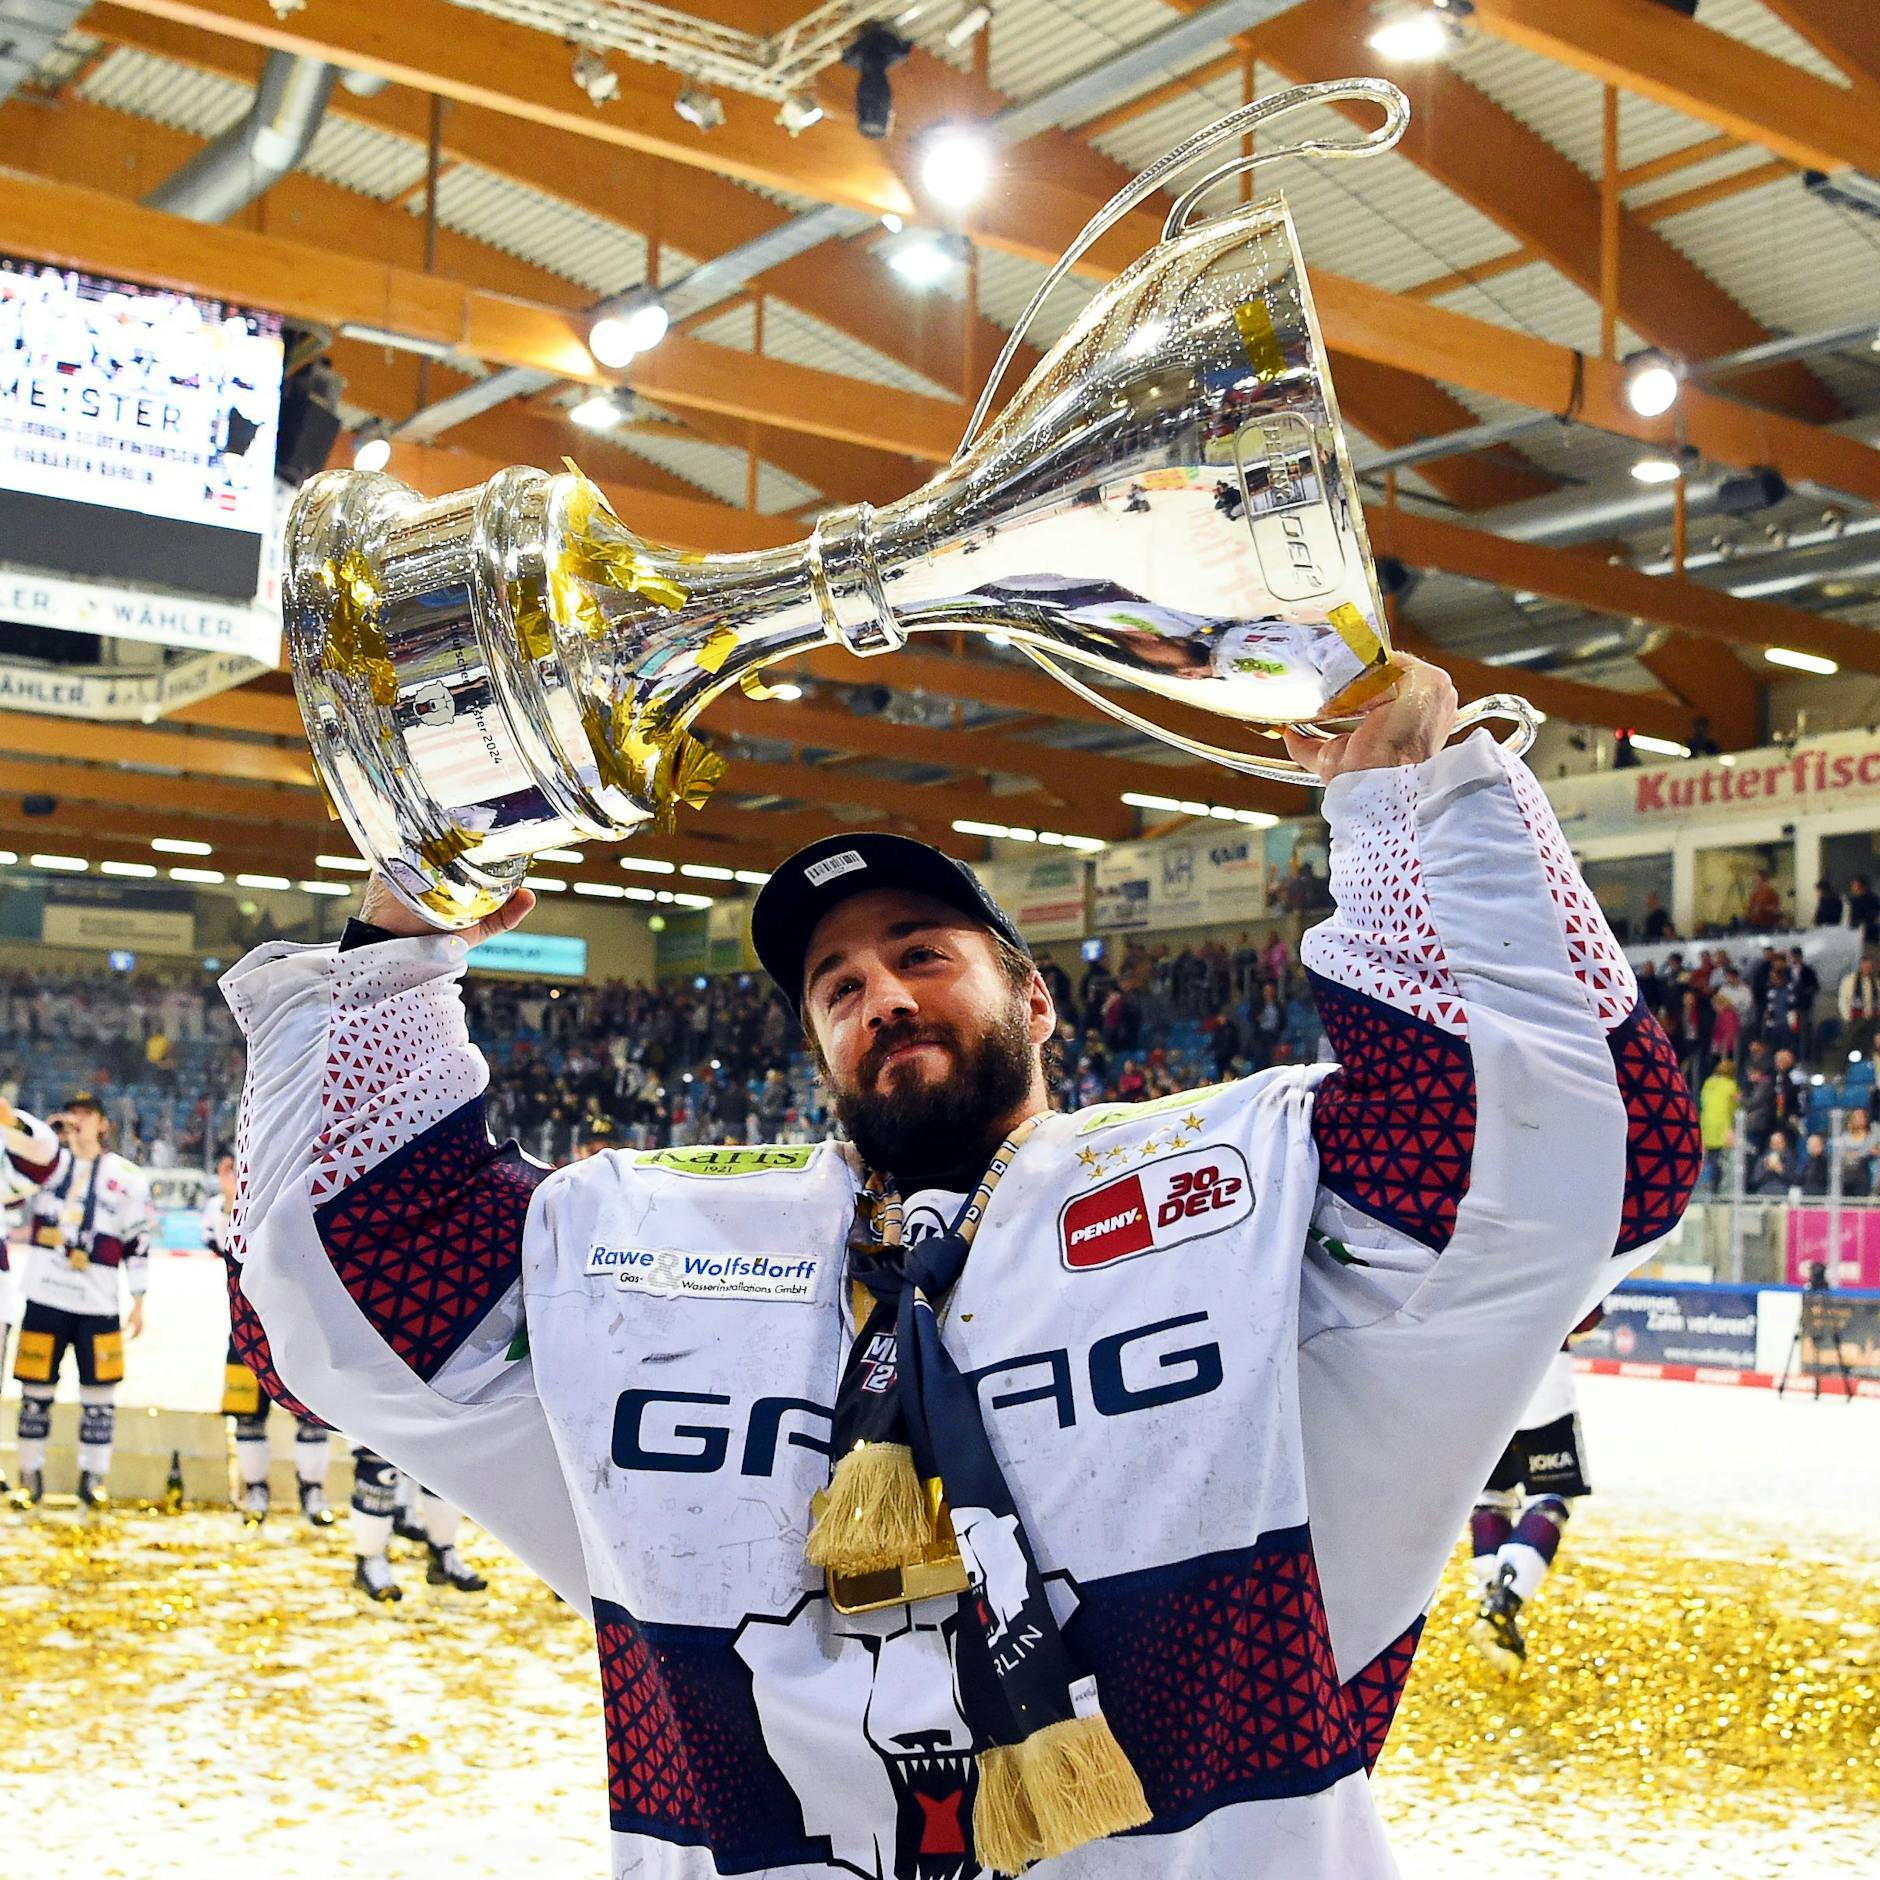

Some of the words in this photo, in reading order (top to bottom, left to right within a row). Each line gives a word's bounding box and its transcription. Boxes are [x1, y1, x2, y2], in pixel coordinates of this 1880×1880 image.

[483, 733, 503, 765] 2024
[703, 1165, 733, 1174] 1921
[1167, 1165, 1220, 1200] 30
[590, 1246, 654, 1267] Rawe
[684, 1256, 817, 1280] Wolfsdorff
[620, 1272, 644, 1284] Gas-
[774, 1285, 808, 1295] GmbH
[993, 1623, 1044, 1679] RLIN
